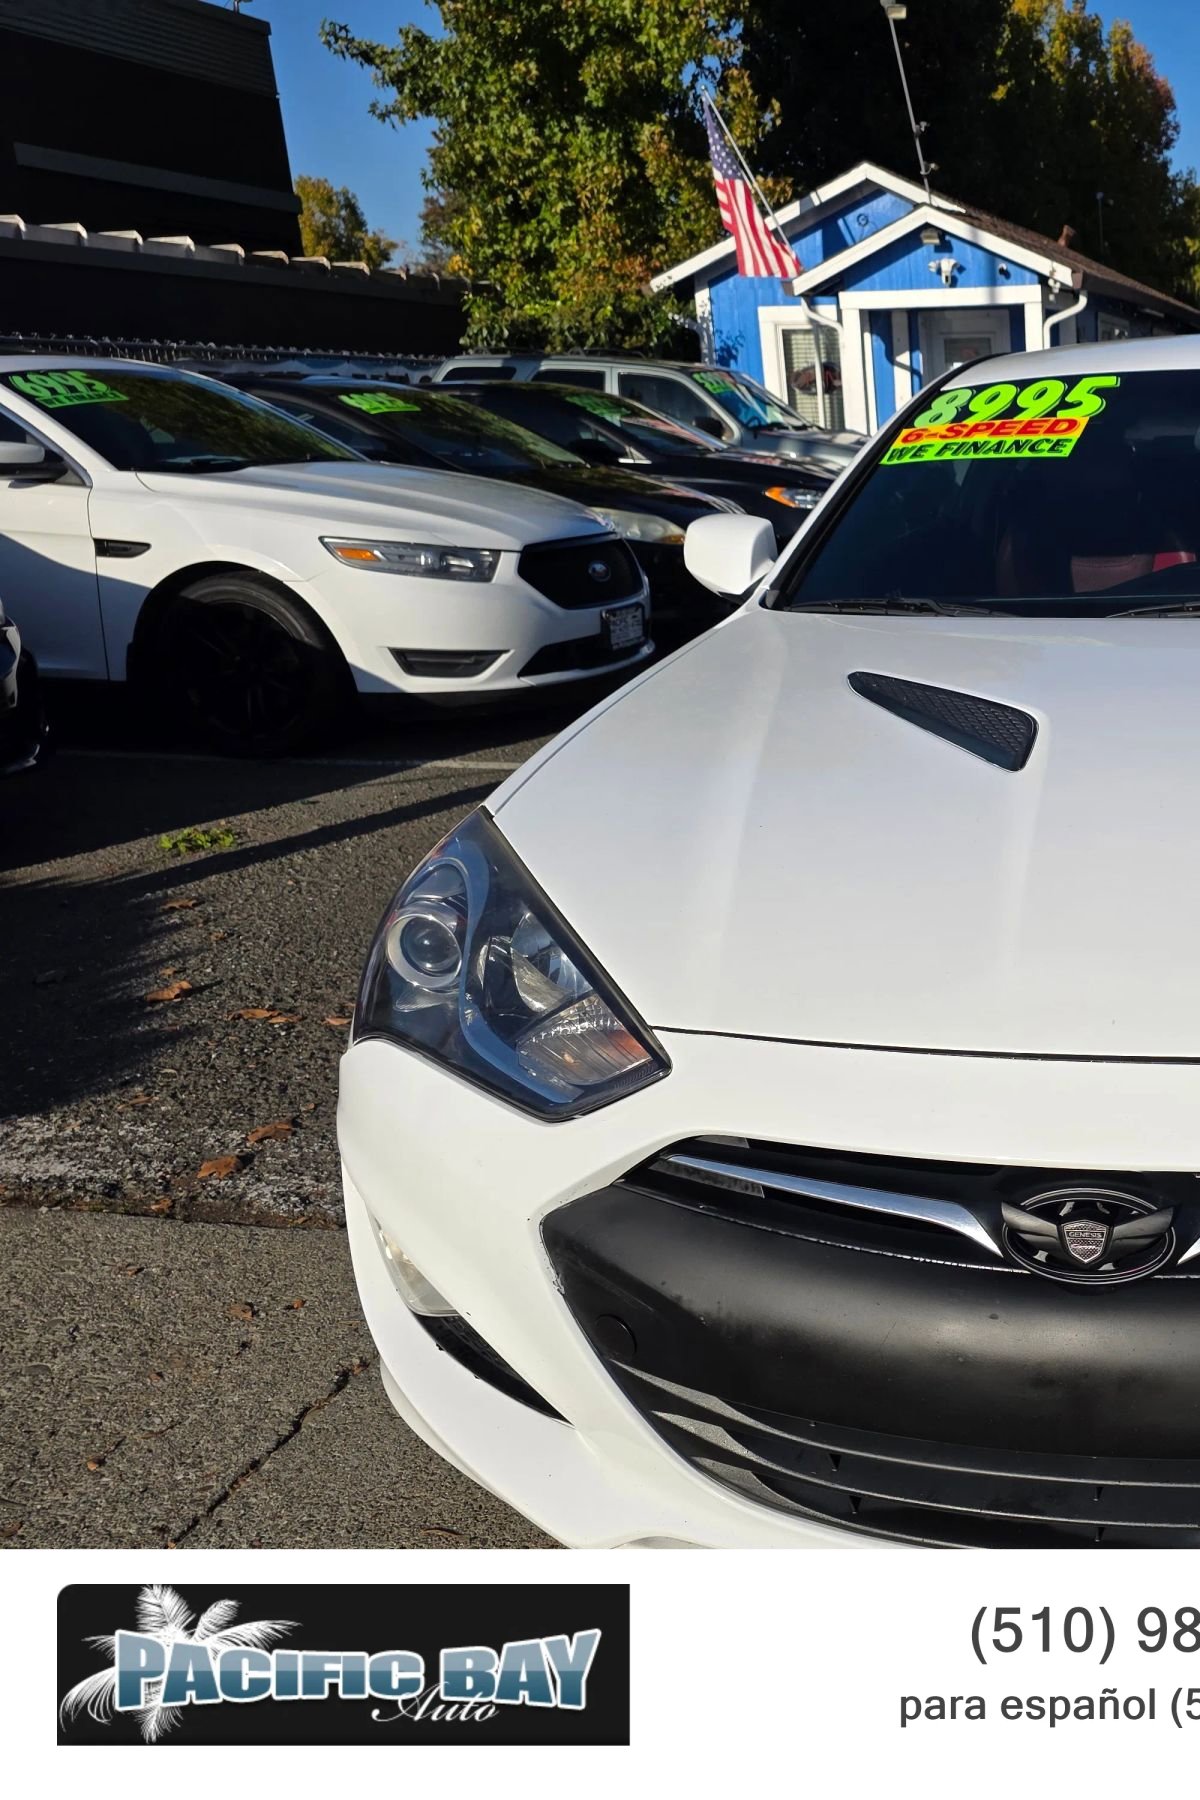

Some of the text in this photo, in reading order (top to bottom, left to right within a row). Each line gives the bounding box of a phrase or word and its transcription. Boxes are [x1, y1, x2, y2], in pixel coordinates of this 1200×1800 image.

[9, 370, 111, 398] 6995
[914, 375, 1119, 428] 8995
[901, 418, 1081, 444] 6-SPEED
[886, 438, 1073, 462] WE FINANCE
